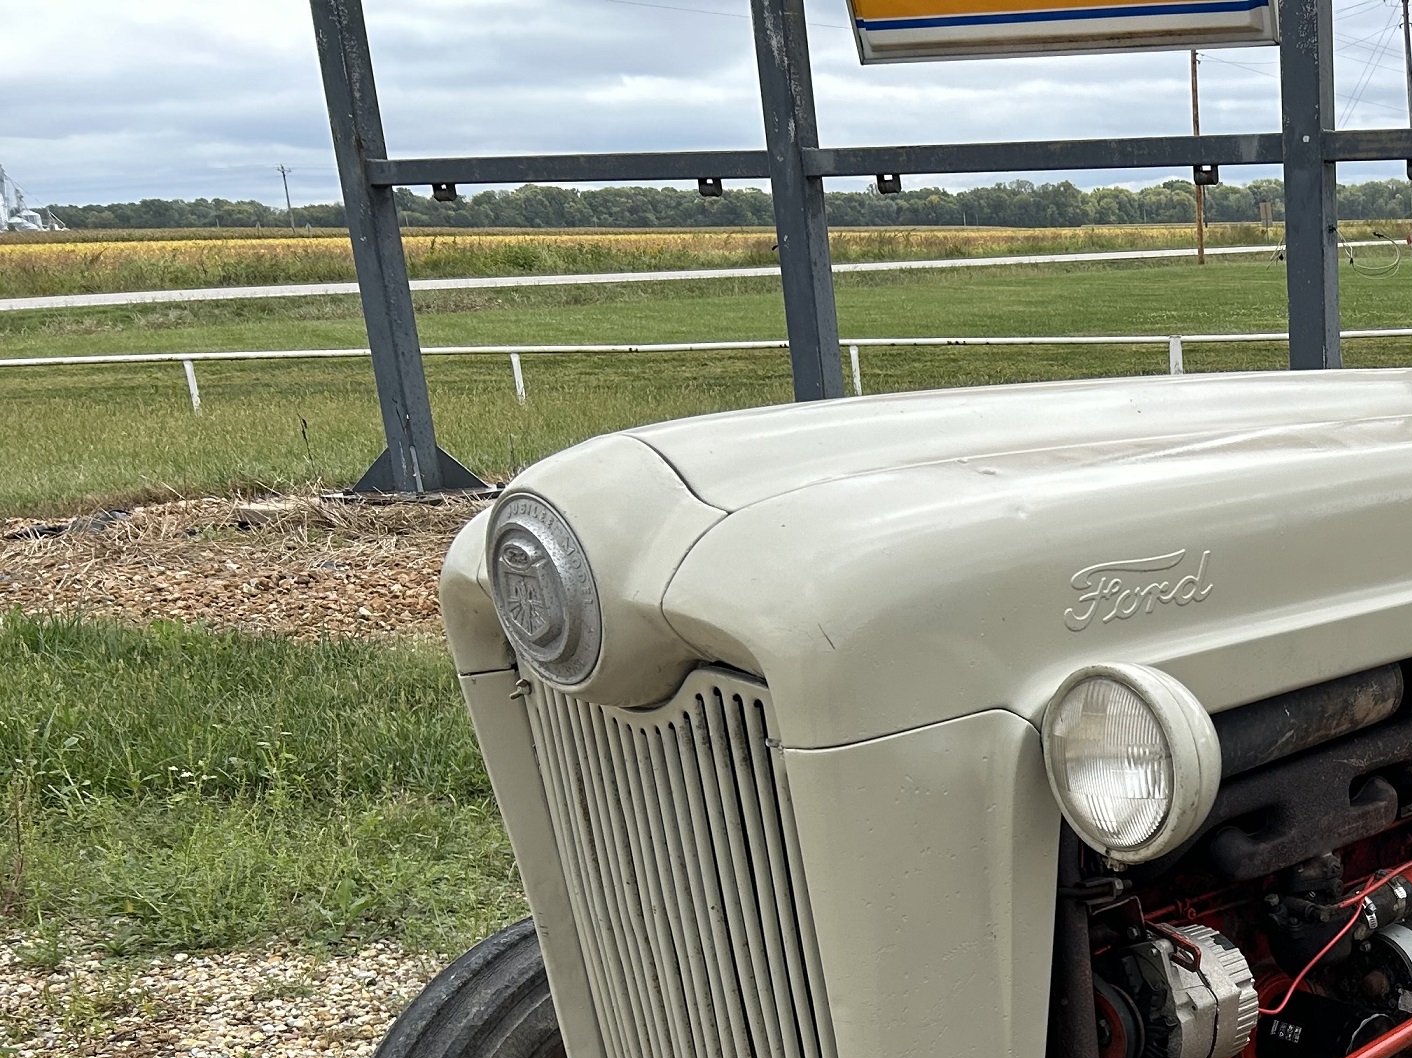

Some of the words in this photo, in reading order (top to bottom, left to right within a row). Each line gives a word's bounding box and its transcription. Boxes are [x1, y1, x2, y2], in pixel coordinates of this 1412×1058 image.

[507, 502, 555, 530] JUBILEE
[561, 537, 594, 605] MODEL
[1064, 549, 1213, 632] Ford
